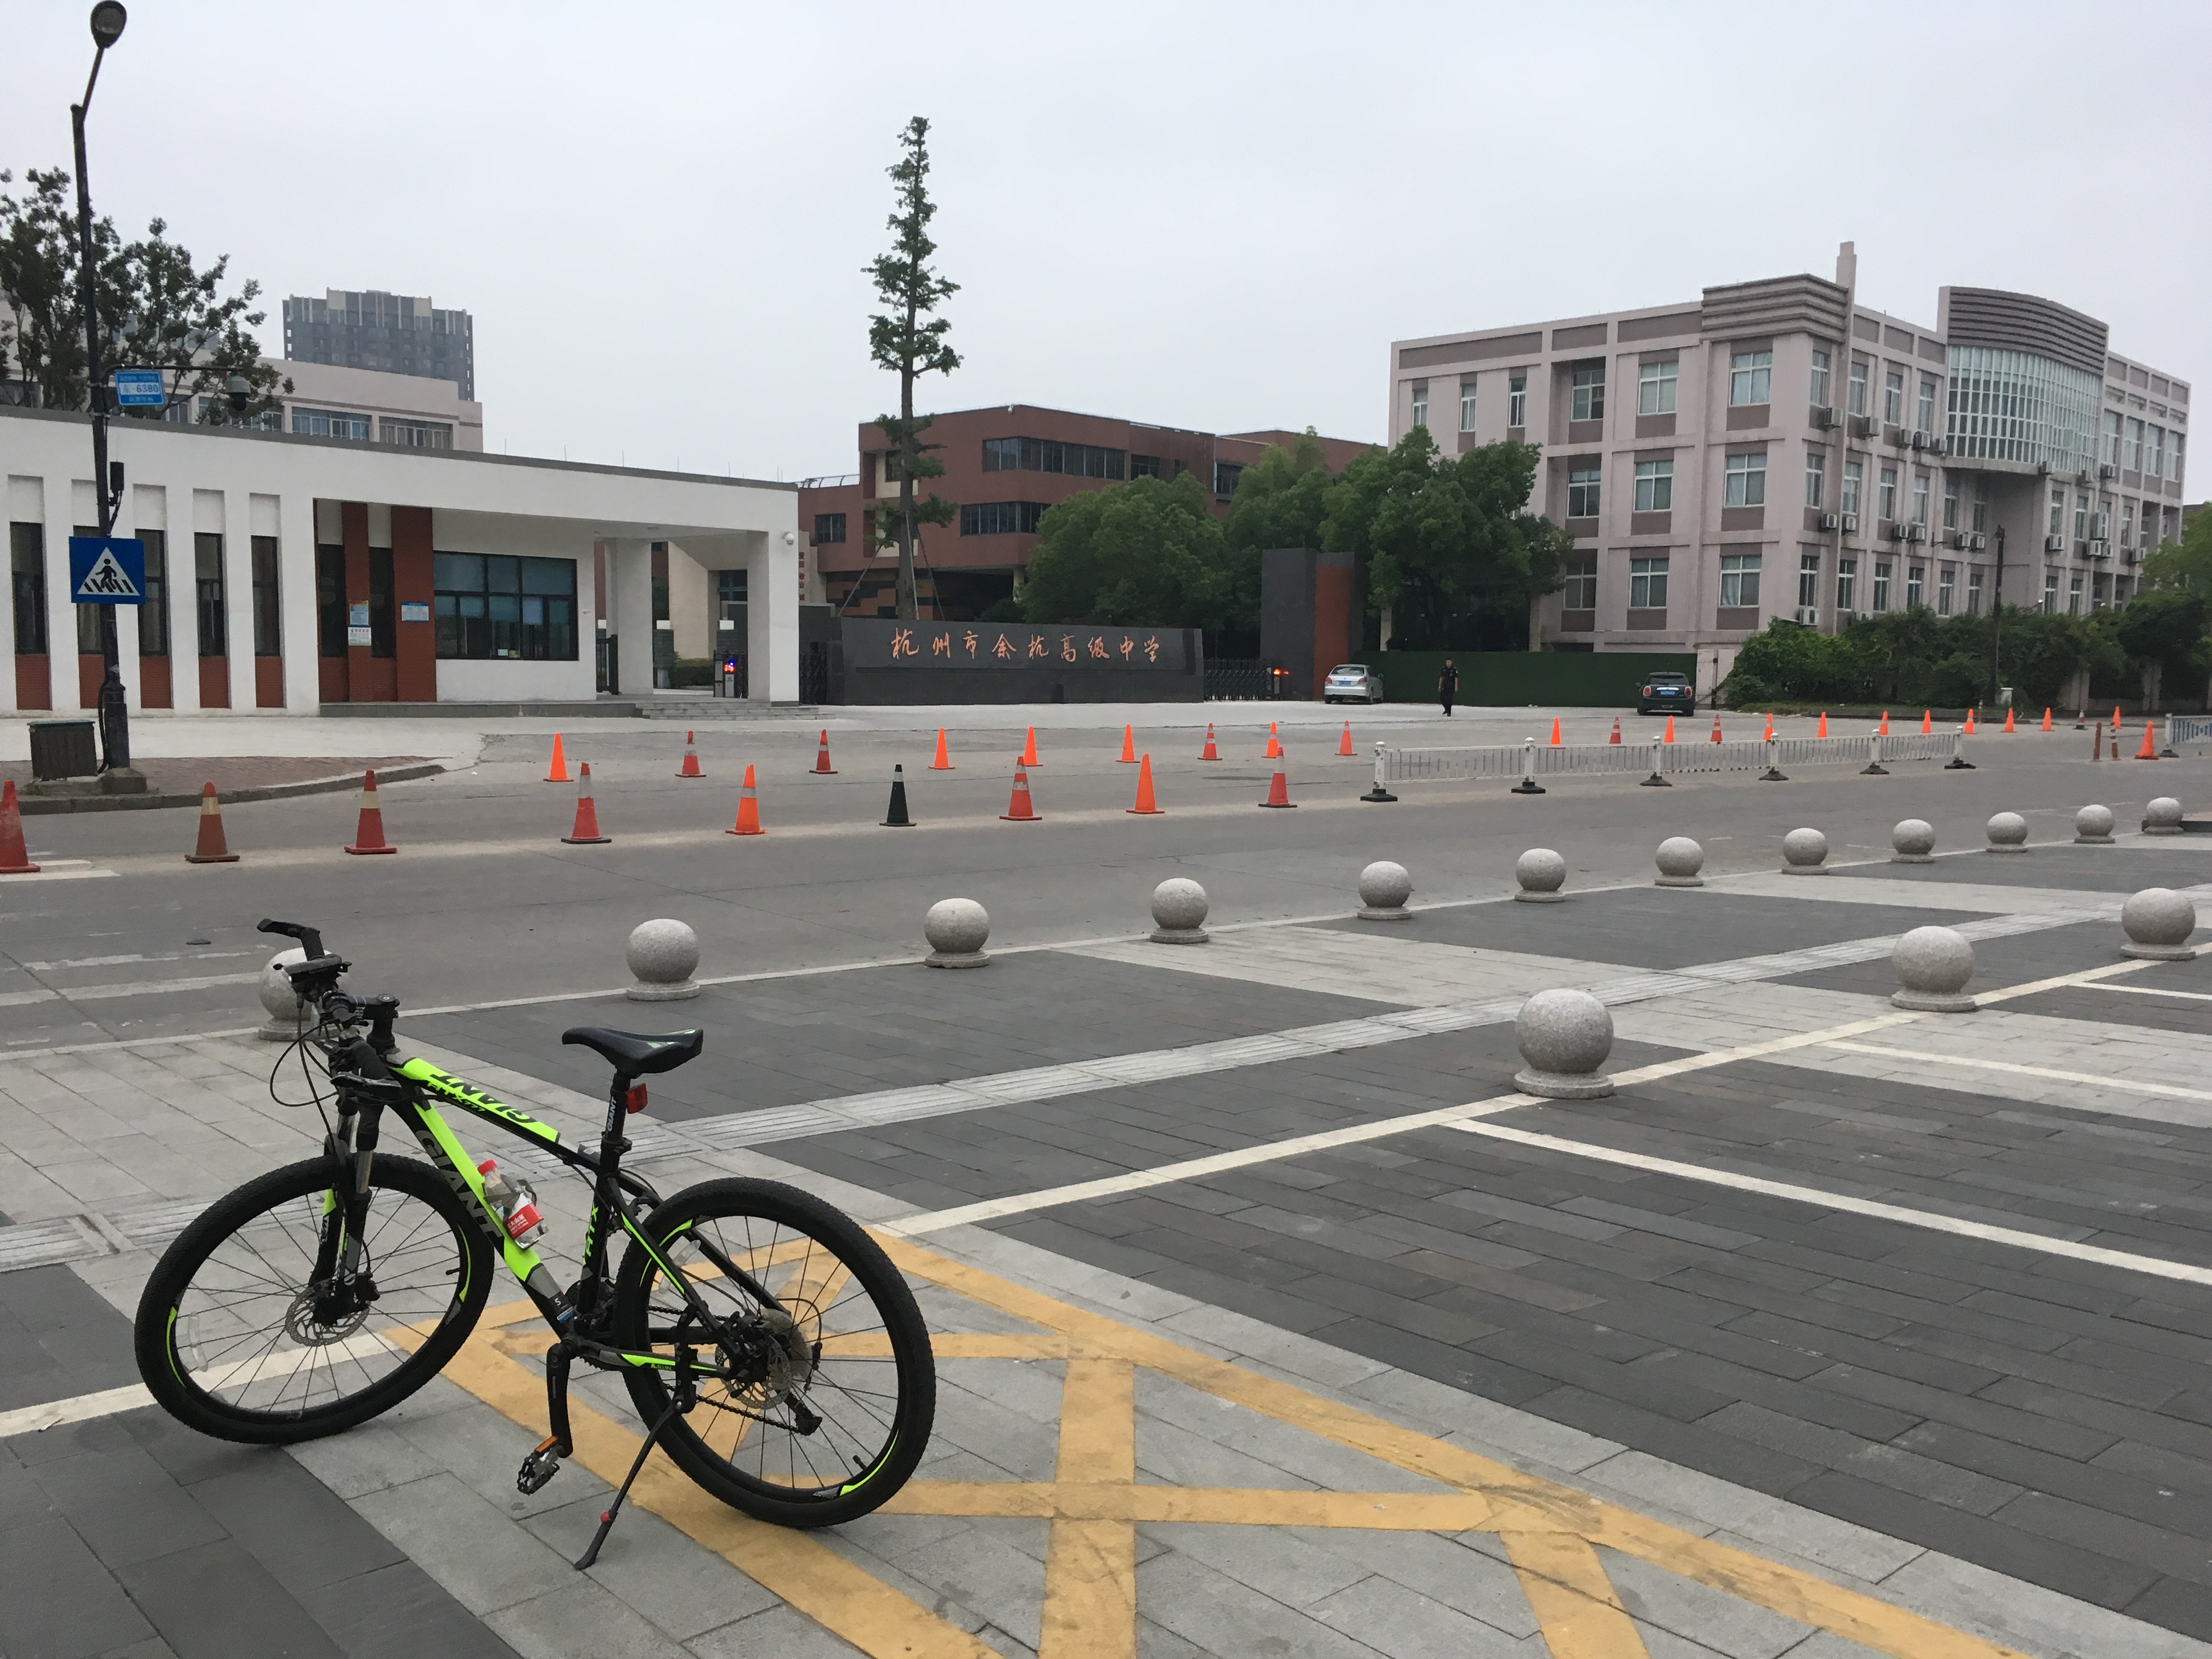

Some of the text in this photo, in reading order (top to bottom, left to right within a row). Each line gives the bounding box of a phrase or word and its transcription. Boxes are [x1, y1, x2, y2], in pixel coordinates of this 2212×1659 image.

[890, 627, 1160, 663] 杭州市余杭高级中学
[429, 1074, 538, 1123] GIANT
[607, 1096, 617, 1132] GIANT
[415, 1130, 503, 1238] GIANT
